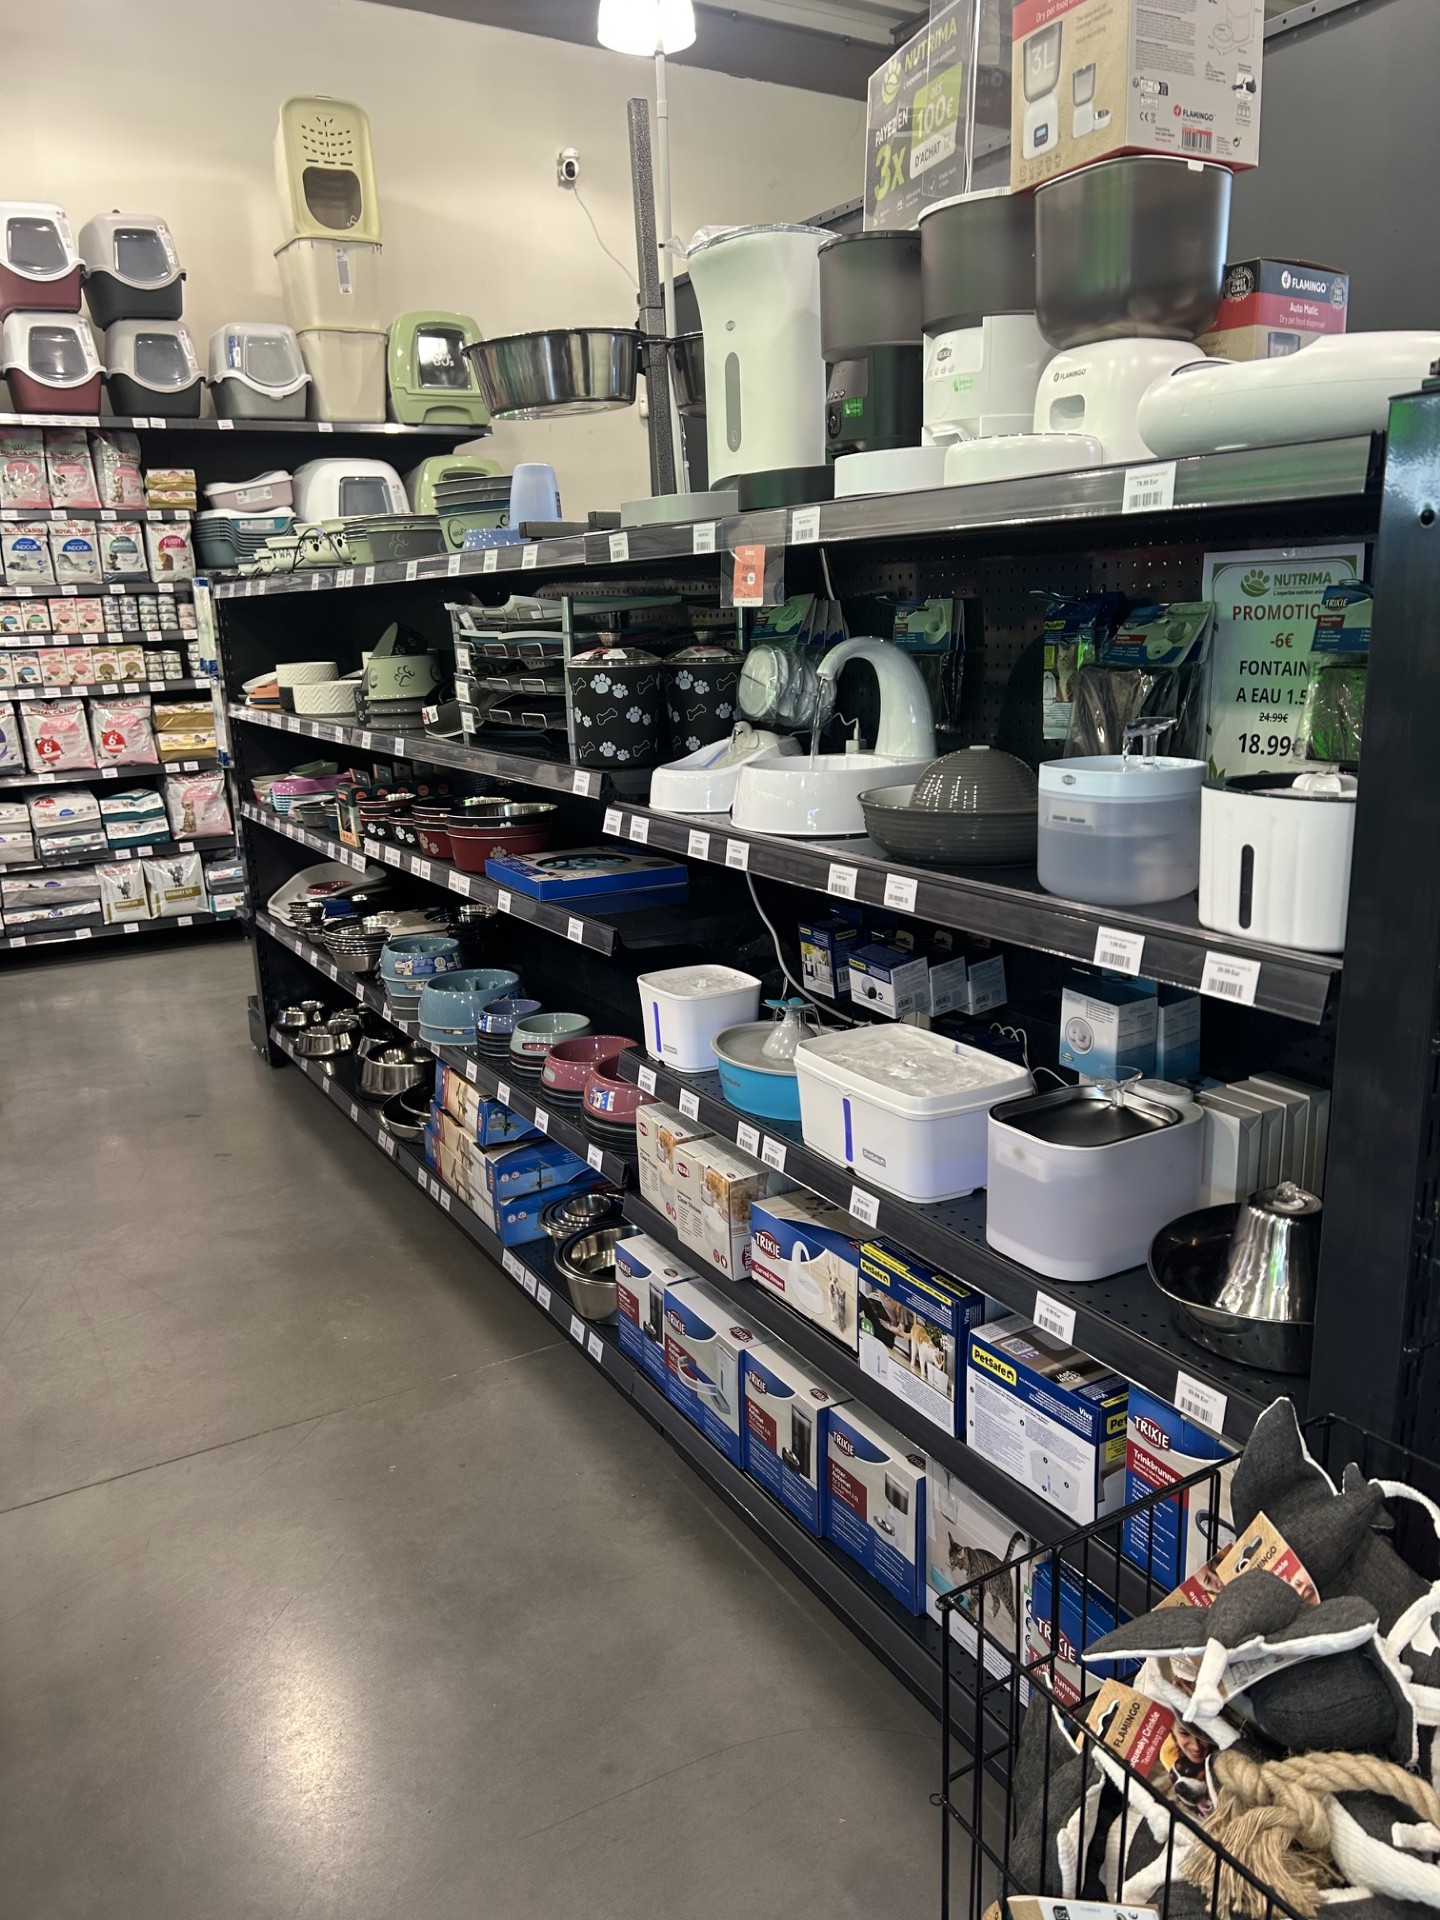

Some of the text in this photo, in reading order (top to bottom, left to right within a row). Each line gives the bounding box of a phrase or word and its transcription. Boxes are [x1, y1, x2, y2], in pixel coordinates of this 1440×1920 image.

[904, 16, 957, 72] NUTRIMA
[1032, 42, 1054, 75] 3L
[917, 96, 954, 139] 100€
[1183, 108, 1214, 122] FLAMINGO
[875, 106, 908, 148] PAYEZ EN
[915, 140, 942, 168] D'ACHAT
[1292, 278, 1326, 293] FLAMINGO
[1290, 302, 1318, 316] Auto Matic
[1280, 314, 1288, 326] Dry
[1296, 317, 1306, 326] food
[1306, 319, 1326, 329] dispenser
[1059, 368, 1086, 381] FLAMINGO
[1274, 572, 1332, 587] NUTRIMA
[1233, 604, 1320, 620] PROMOTIO
[1325, 598, 1349, 608] TRIXIE
[1270, 632, 1294, 648] -6€
[1236, 688, 1246, 702] A
[1252, 688, 1282, 704] EAU
[678, 1194, 702, 1215] Clear Stream
[755, 1232, 781, 1258] TRIXIE
[618, 1259, 632, 1276] TRIXIE
[755, 1264, 784, 1290] Curved Stream
[862, 1261, 884, 1280] PetSafe
[941, 1304, 952, 1315] Viva
[667, 1310, 686, 1334] TRIXIE
[974, 1350, 1006, 1376] PetSafe
[748, 1370, 766, 1393] TRIXIE
[1202, 1395, 1210, 1404] Eur
[1079, 1406, 1093, 1420] Viva
[832, 1430, 854, 1456] TRIXIE
[1134, 1415, 1170, 1450] TRIXIE
[1133, 1448, 1177, 1482] Trinkbrunne
[1114, 1702, 1141, 1748] FLAMINGO
[1142, 1711, 1160, 1736] Crinkle
[1141, 1746, 1156, 1765] Textile
[1154, 1734, 1162, 1747] dog
